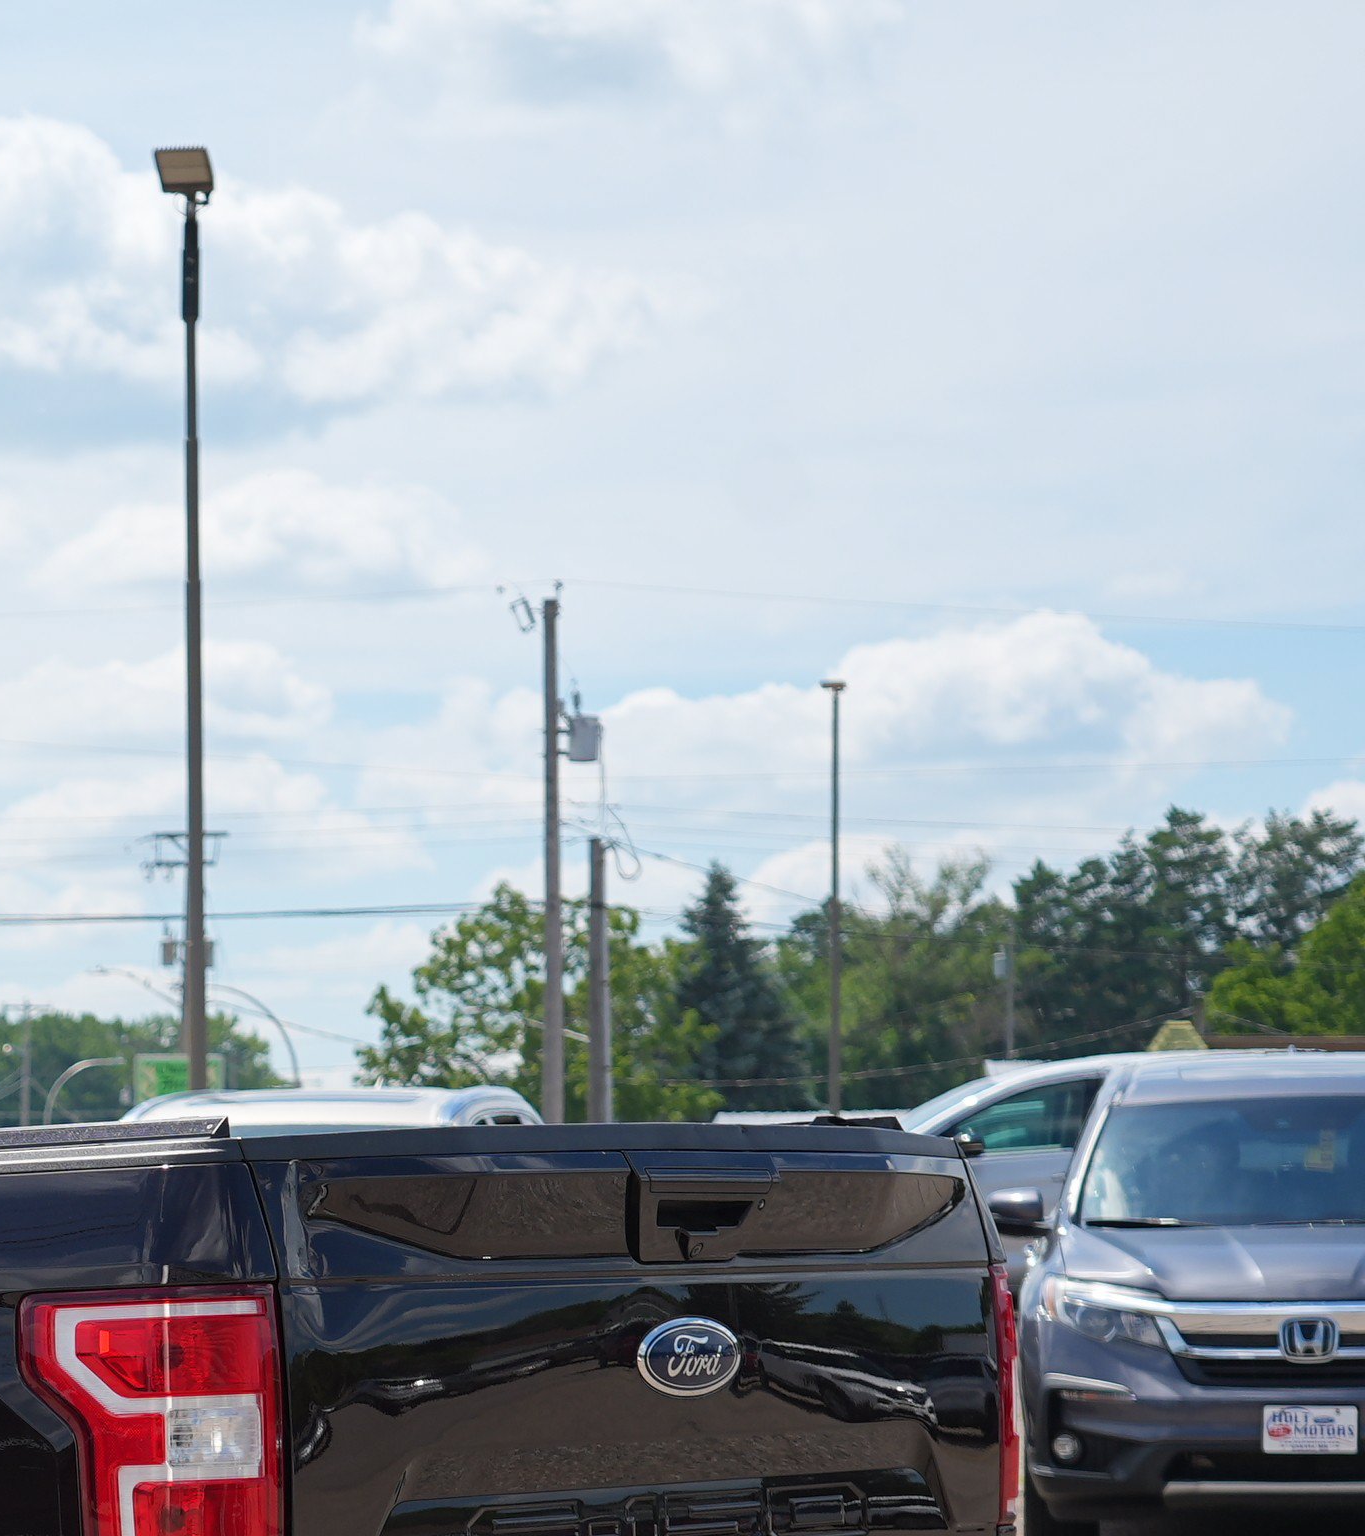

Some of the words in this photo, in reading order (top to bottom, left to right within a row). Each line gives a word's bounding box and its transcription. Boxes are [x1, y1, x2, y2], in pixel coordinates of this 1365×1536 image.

[667, 1335, 723, 1378] Ford
[1272, 1411, 1310, 1423] HOLT
[1294, 1424, 1355, 1437] MOTORS
